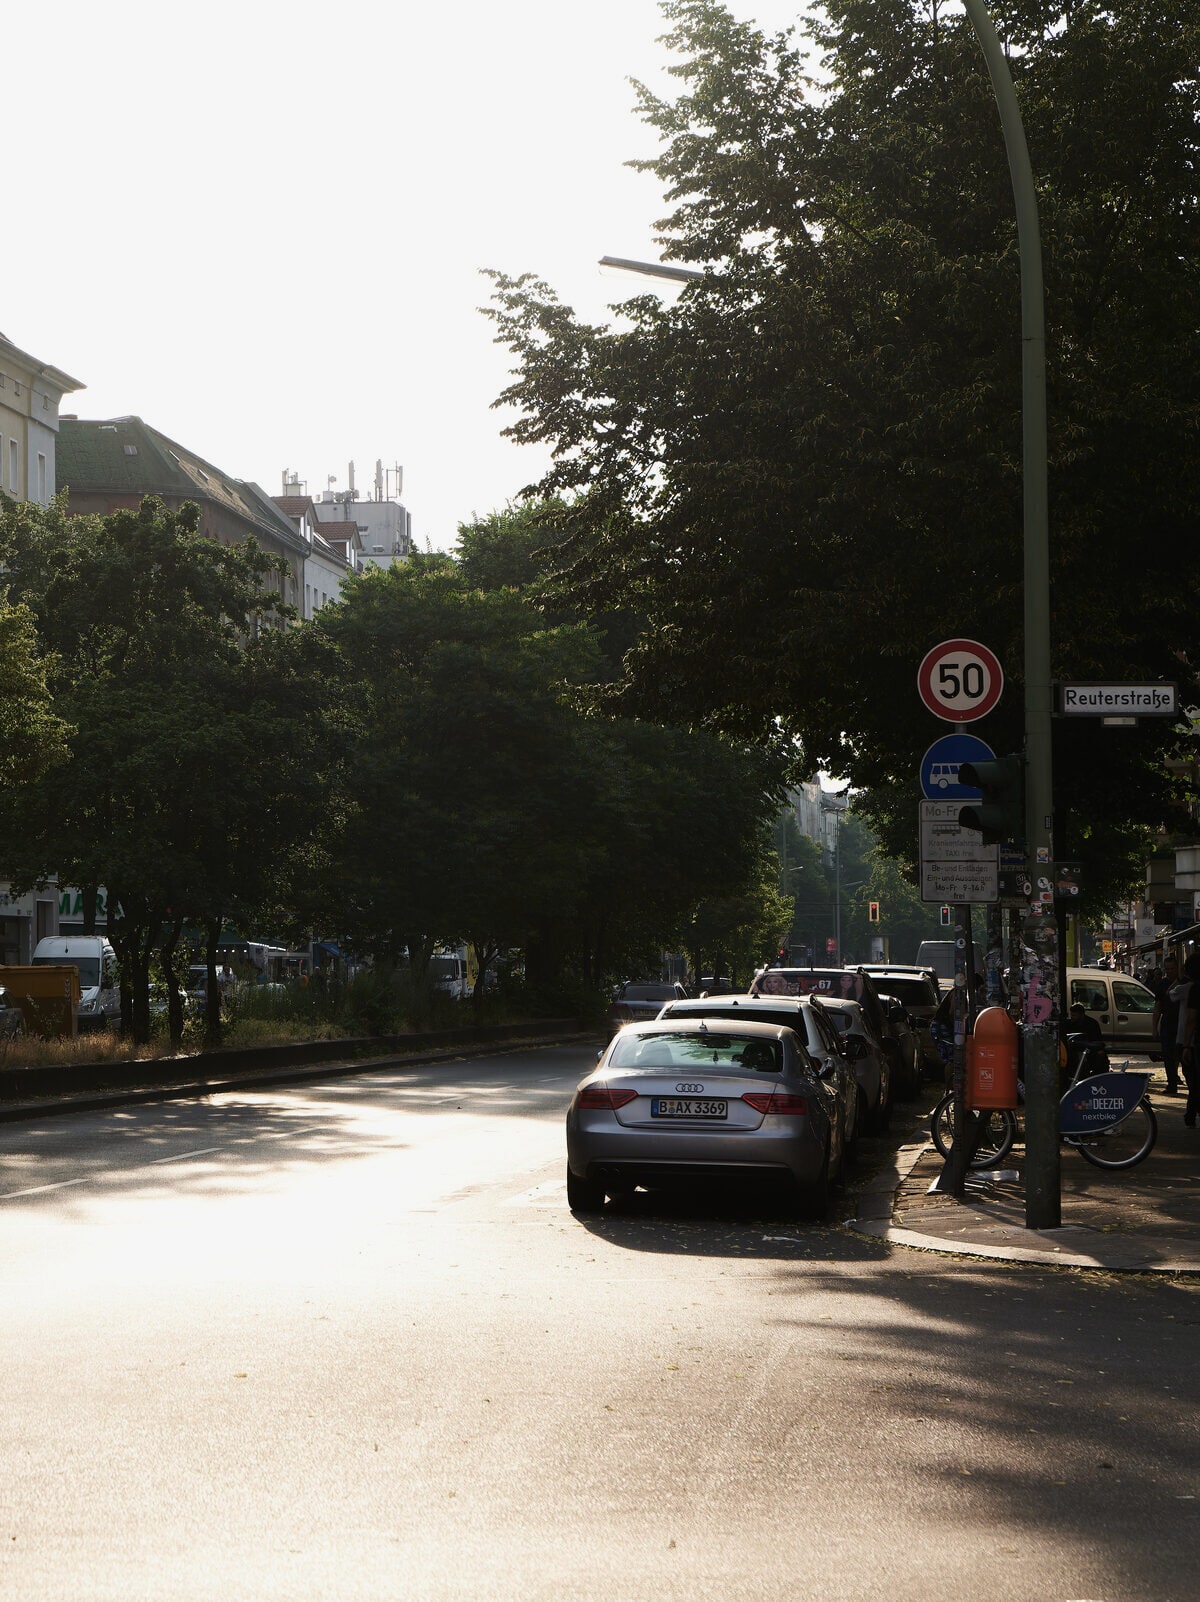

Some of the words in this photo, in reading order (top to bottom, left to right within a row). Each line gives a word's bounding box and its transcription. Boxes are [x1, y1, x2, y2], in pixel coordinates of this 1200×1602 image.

[939, 663, 984, 698] 50
[1066, 690, 1170, 708] Reuterstraße
[925, 806, 958, 816] Mo-Fr
[818, 979, 832, 990] 67
[660, 1101, 667, 1113] B
[676, 1101, 691, 1114] AX
[694, 1102, 725, 1115] 3369
[1092, 1098, 1124, 1110] DEEZER
